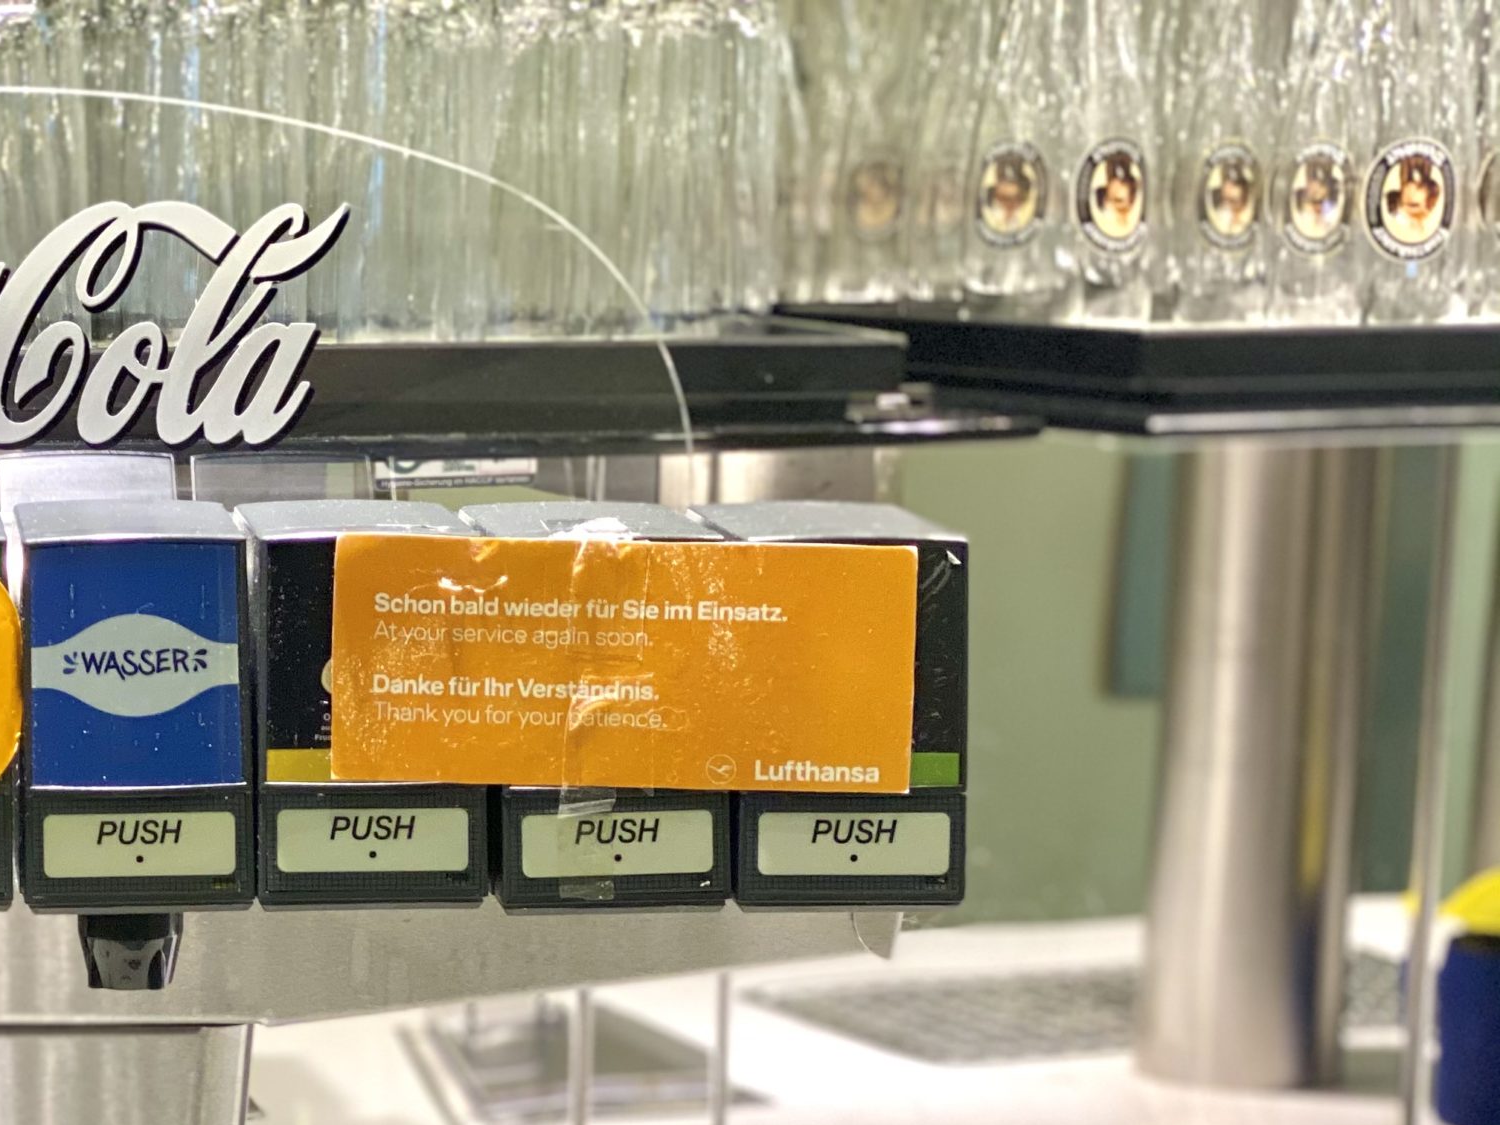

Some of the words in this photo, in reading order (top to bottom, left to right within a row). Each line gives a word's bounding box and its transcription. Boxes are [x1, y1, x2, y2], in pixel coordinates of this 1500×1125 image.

[374, 592, 446, 614] Schon
[450, 595, 499, 616] bald
[504, 597, 582, 618] wieder
[586, 599, 618, 618] für
[622, 599, 660, 620] Sie
[664, 600, 693, 620] im
[697, 600, 788, 622] Einsatz.
[373, 620, 398, 640] At
[401, 627, 448, 645] your
[452, 624, 528, 643] service
[532, 627, 589, 649] again
[595, 631, 654, 647] soon.
[82, 647, 190, 682] WASSER
[373, 673, 444, 695] Danke
[448, 676, 480, 696] für
[483, 676, 514, 697] Ihr
[517, 678, 660, 701] Verständnis.
[374, 701, 439, 722] Thank
[442, 708, 480, 727] you
[484, 704, 513, 724] for
[517, 710, 564, 729] your
[568, 711, 668, 731] patience.
[754, 760, 881, 784] Lufthansa
[96, 820, 182, 844] PUSH
[330, 816, 416, 840] PUSH
[575, 818, 660, 844] PUSH
[811, 820, 897, 843] PUSH
